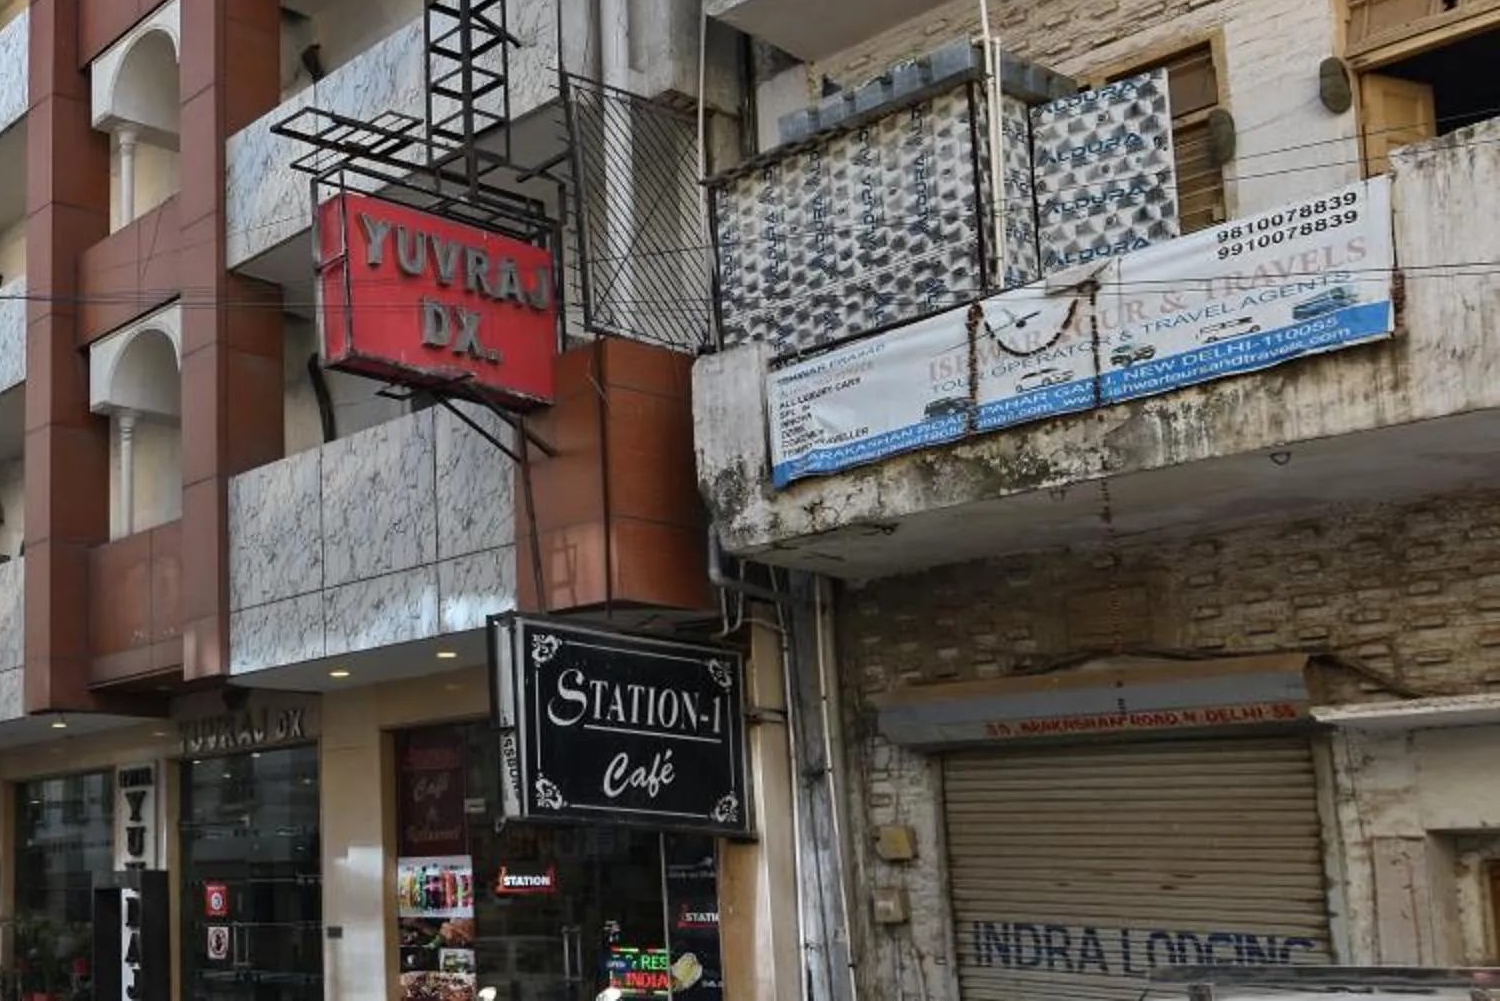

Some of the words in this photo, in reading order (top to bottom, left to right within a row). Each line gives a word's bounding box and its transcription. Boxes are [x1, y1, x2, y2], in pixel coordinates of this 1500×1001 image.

[1217, 191, 1358, 244] 9810078839
[1217, 210, 1359, 261] 9910078839
[360, 212, 550, 310] YUVRAJ
[1204, 236, 1367, 293] TRAVELS
[1143, 300, 1239, 335] TRAVEL
[1242, 272, 1351, 308] AGENTS
[1124, 360, 1175, 383] NEW
[547, 668, 722, 734] STATION-1
[603, 749, 676, 798] Café
[503, 875, 551, 887] STATION
[972, 920, 1109, 974] INDRA
